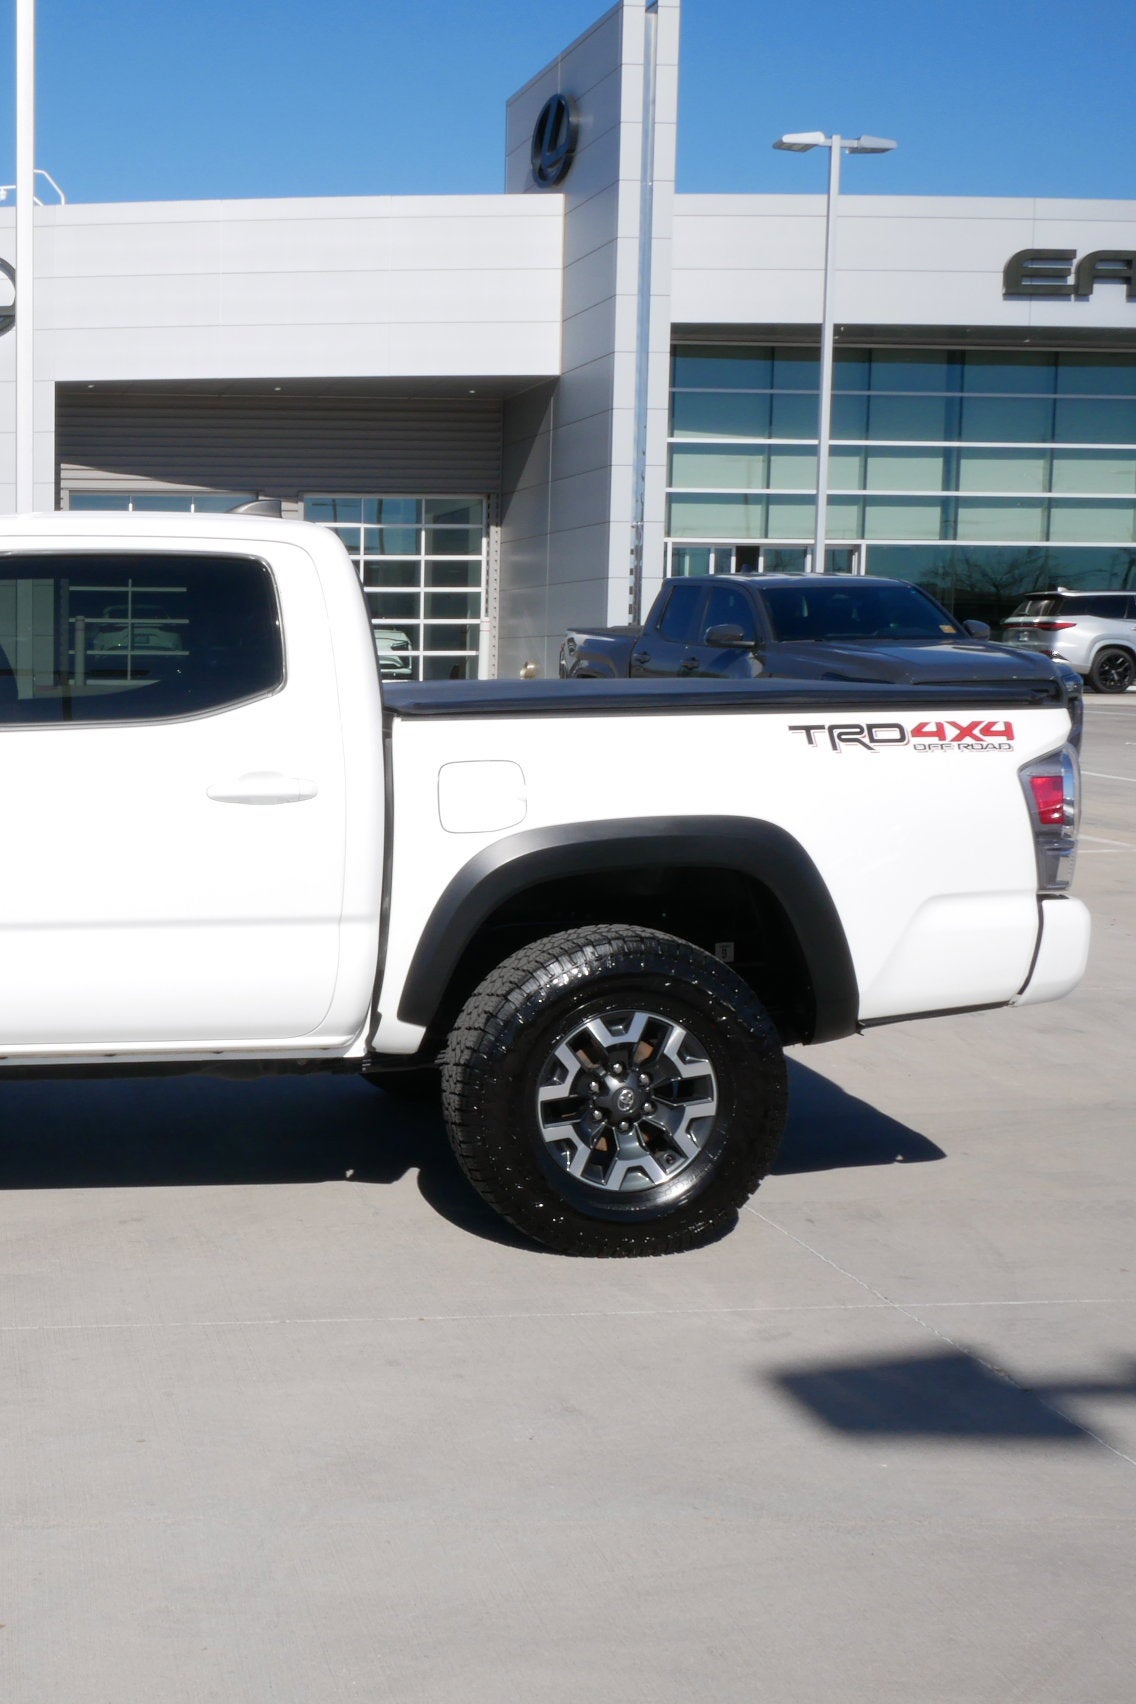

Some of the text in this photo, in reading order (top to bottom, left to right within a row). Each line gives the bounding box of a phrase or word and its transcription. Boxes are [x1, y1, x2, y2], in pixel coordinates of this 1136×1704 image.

[788, 723, 910, 753] TRD
[913, 742, 1013, 751] OFF ROAD
